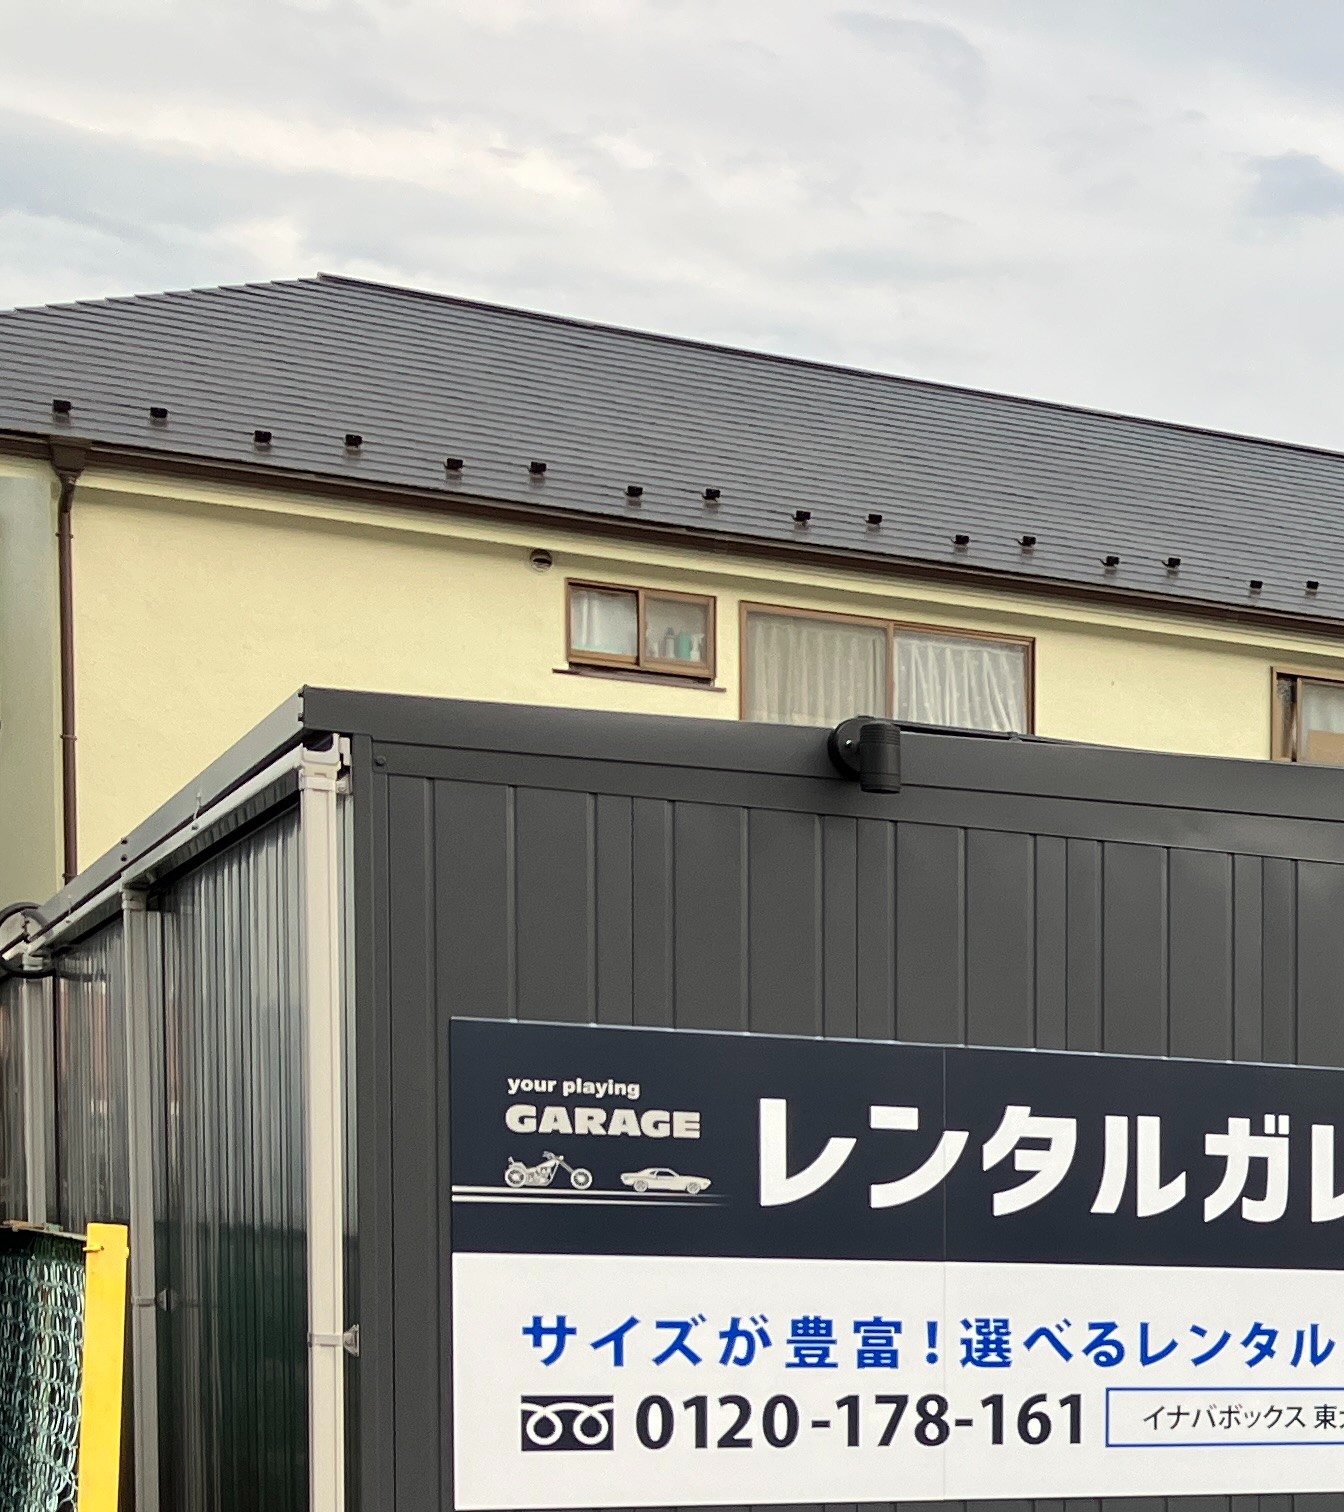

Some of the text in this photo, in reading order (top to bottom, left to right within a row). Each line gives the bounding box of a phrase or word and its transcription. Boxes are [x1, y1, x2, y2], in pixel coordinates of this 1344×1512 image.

[507, 1077, 640, 1100] your playing
[505, 1104, 701, 1140] GARAGE
[635, 1393, 1083, 1450] 0120-178-161
[1141, 1404, 1306, 1431] イナバボックス
